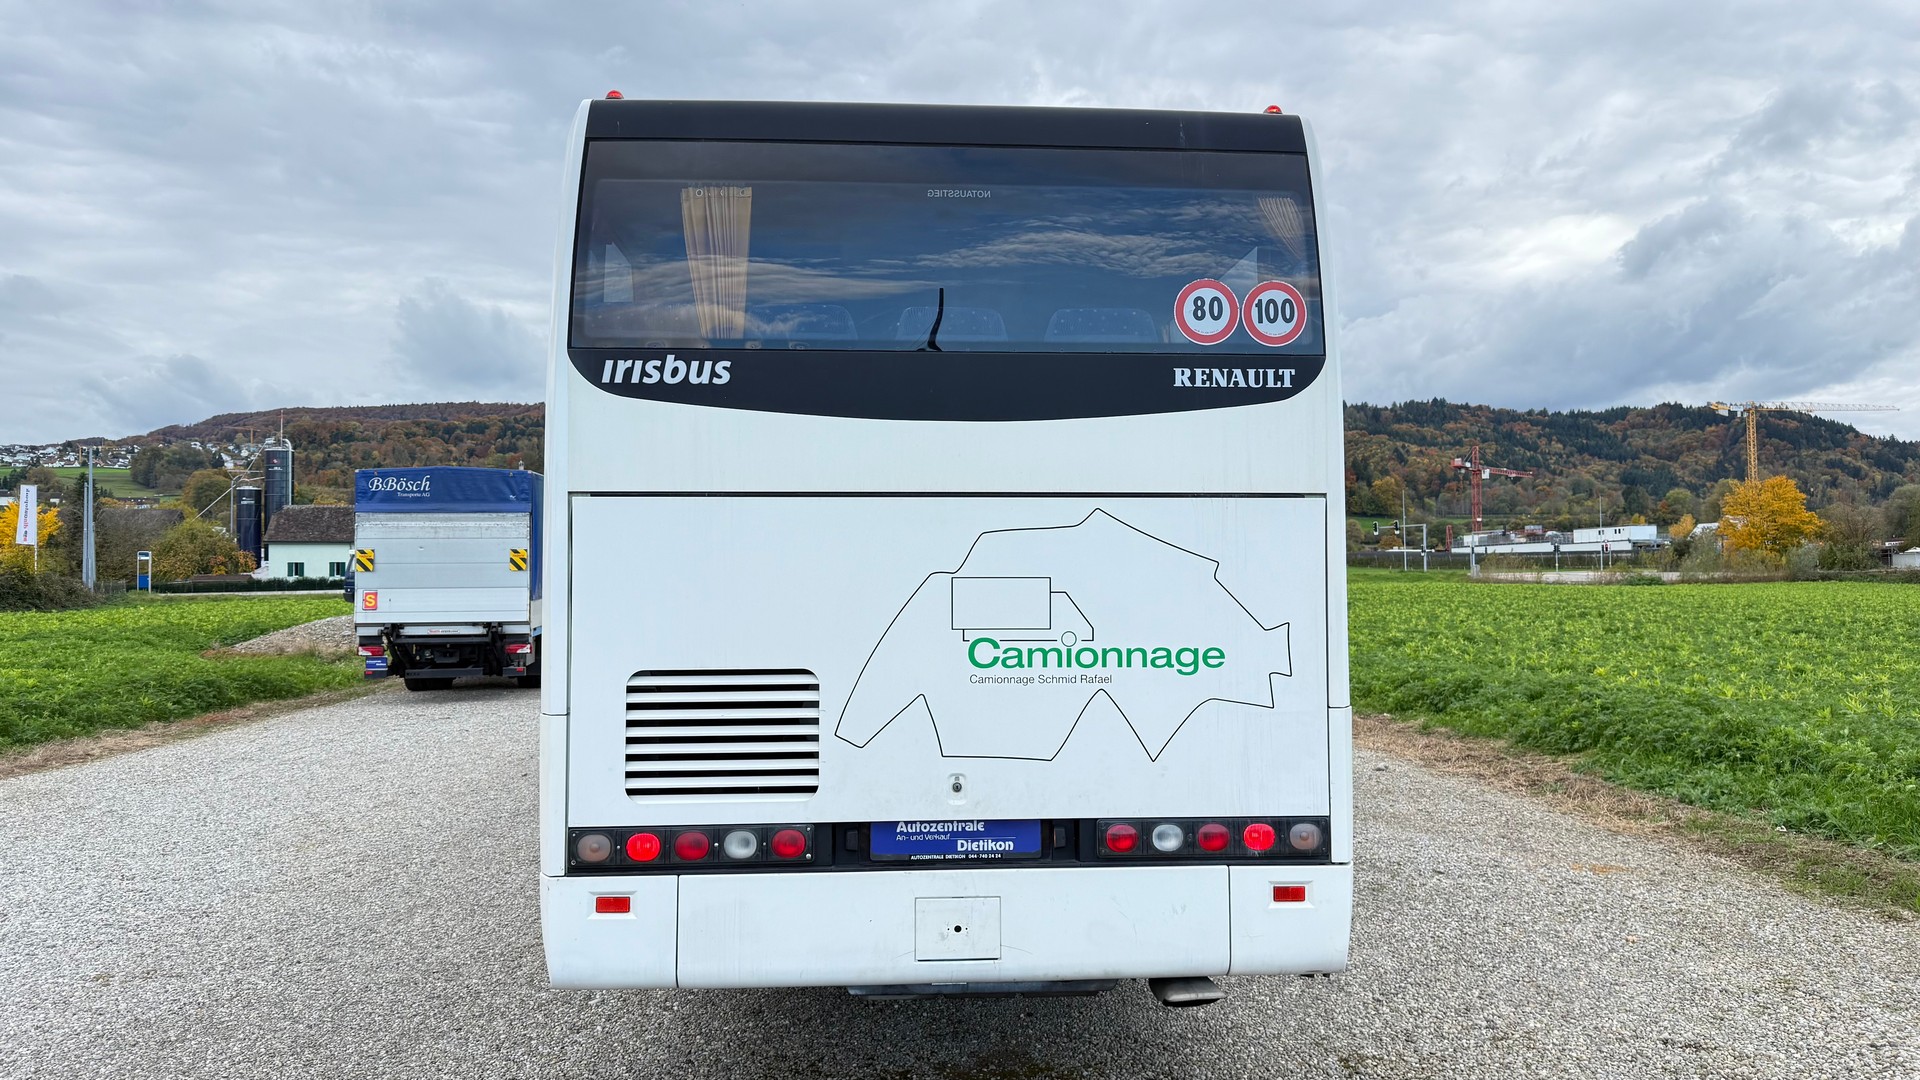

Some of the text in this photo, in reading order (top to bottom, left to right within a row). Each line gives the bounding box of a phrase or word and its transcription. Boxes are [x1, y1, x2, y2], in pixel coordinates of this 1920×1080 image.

[1193, 296, 1223, 321] 80
[1255, 298, 1295, 324] 100
[1173, 367, 1296, 388] RENAULT
[368, 475, 431, 491] B.Bösch
[365, 594, 376, 607] S
[967, 637, 1226, 676] Camionnage
[969, 674, 1113, 685] Camionnage Schmid Rafael
[896, 821, 985, 833] Autozentrale
[925, 833, 950, 841] Verkauf
[957, 839, 1014, 851] Dietikon
